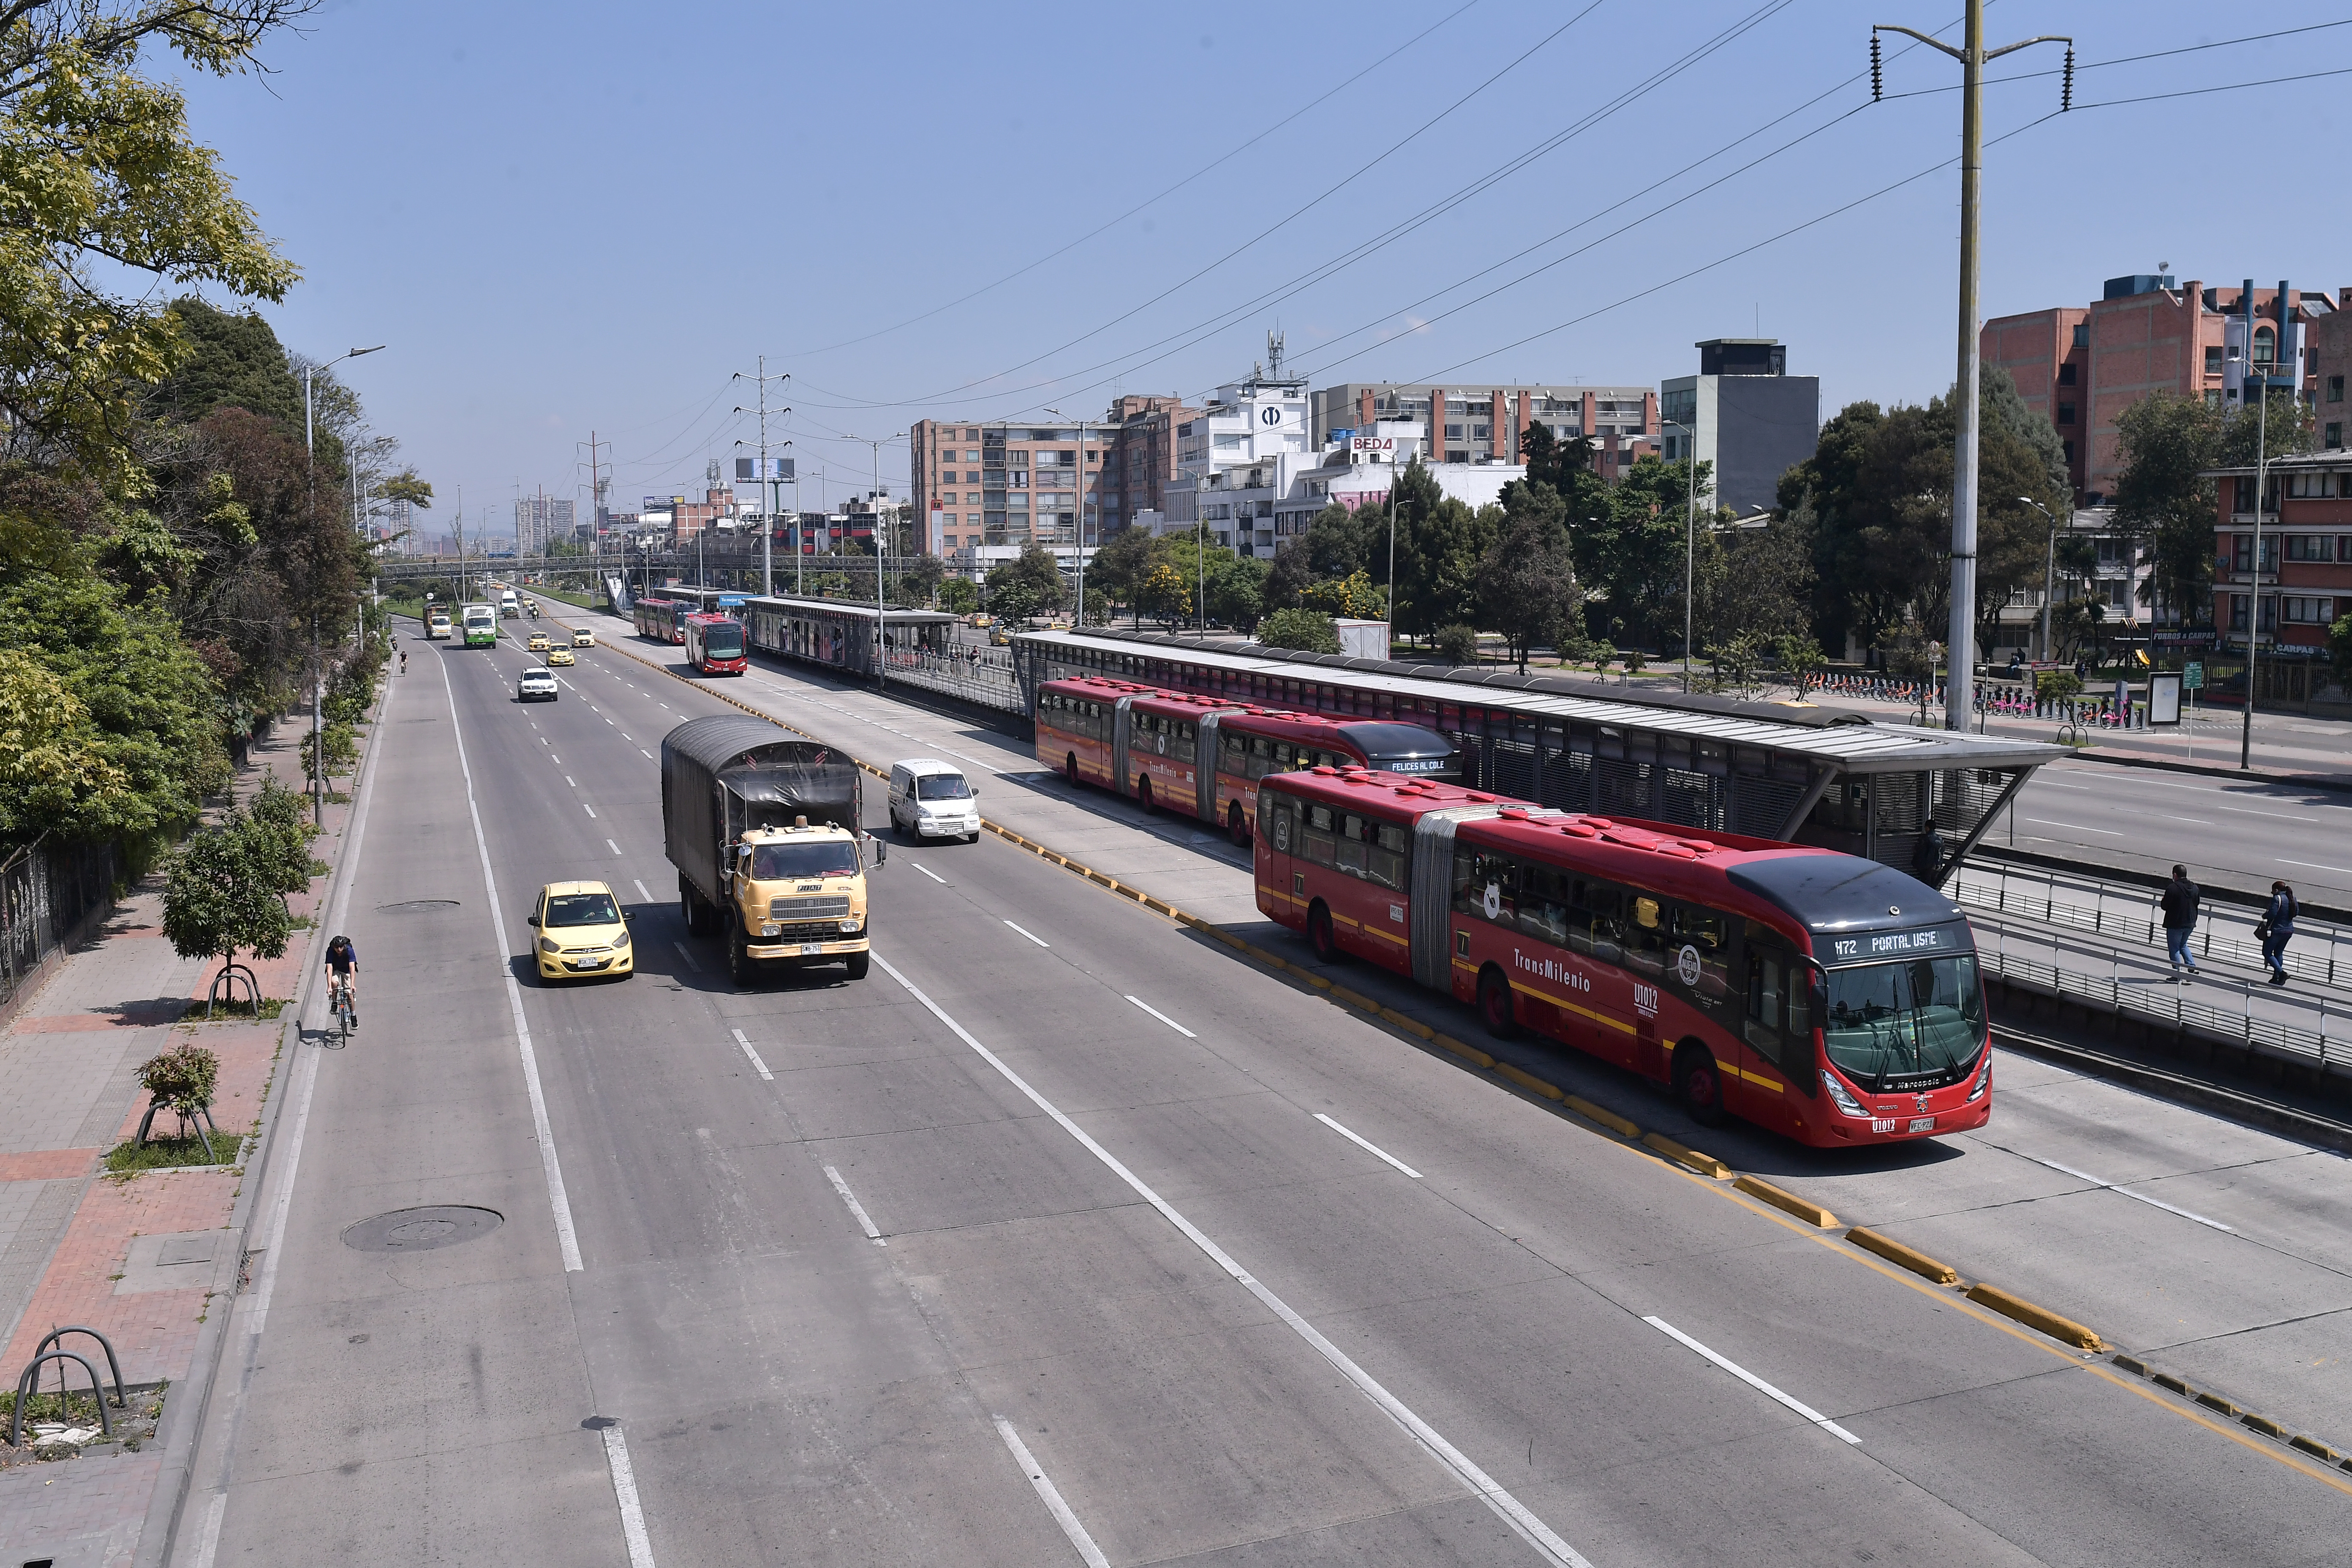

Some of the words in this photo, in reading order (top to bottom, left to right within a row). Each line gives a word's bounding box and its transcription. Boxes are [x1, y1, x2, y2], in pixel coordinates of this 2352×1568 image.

[1354, 438, 1392, 449] BEDA
[1149, 761, 1176, 778] TransMilenio
[1392, 762, 1418, 771] FELICES
[1420, 762, 1428, 770] AL
[1429, 760, 1444, 769] COLE
[1872, 934, 1911, 952] PORTAL
[1913, 931, 1937, 947] USME
[1514, 948, 1590, 992] TransMilenio
[1682, 958, 1697, 972] NUEVO
[1634, 983, 1658, 1010] U1012
[1897, 1078, 1940, 1089] Marcopolo
[1873, 1119, 1895, 1131] U1012
